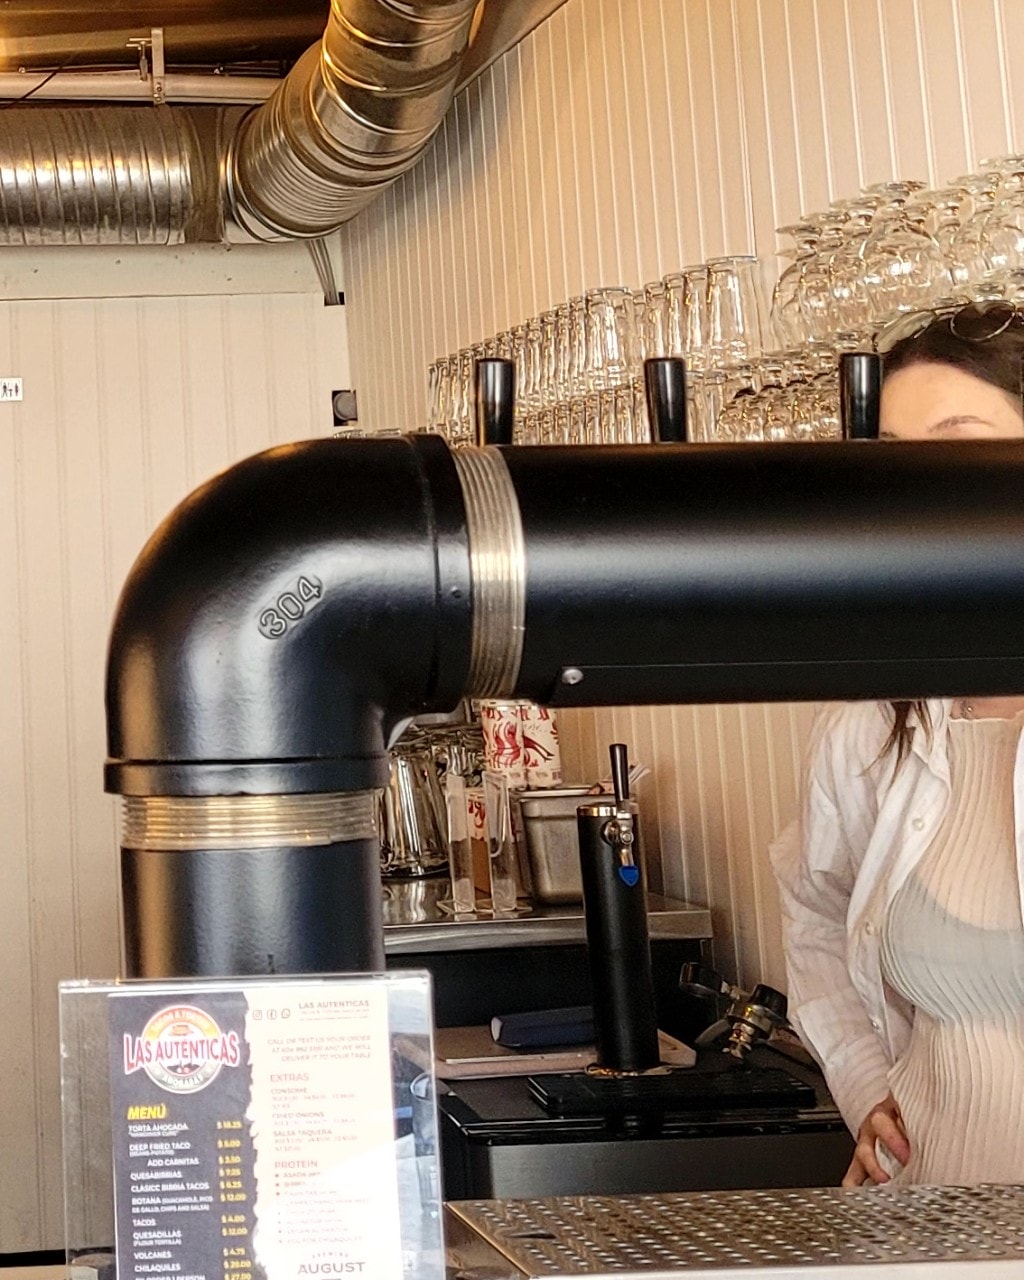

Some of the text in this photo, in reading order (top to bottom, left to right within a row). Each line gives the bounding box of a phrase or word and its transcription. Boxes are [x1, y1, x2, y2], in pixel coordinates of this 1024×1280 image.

[259, 575, 321, 637] 304
[124, 1033, 152, 1073] LAS
[270, 1073, 310, 1083] EXTRAS
[128, 1124, 152, 1132] TORTA
[129, 1143, 148, 1151] DEEP
[150, 1142, 171, 1150] FRIED
[171, 1141, 191, 1149] TACO
[147, 1159, 164, 1167] ADD
[165, 1157, 200, 1166] CARNITAS
[275, 1160, 318, 1169] PROTEIN
[186, 1182, 210, 1191] TACOS
[132, 1197, 161, 1205] BOTANA
[133, 1218, 156, 1226] TACOS
[133, 1230, 182, 1240] QUESADILLAS
[134, 1251, 172, 1260] VOLCANES
[135, 1263, 181, 1272] CHILAQUILES
[298, 1262, 366, 1275] AUGUST
